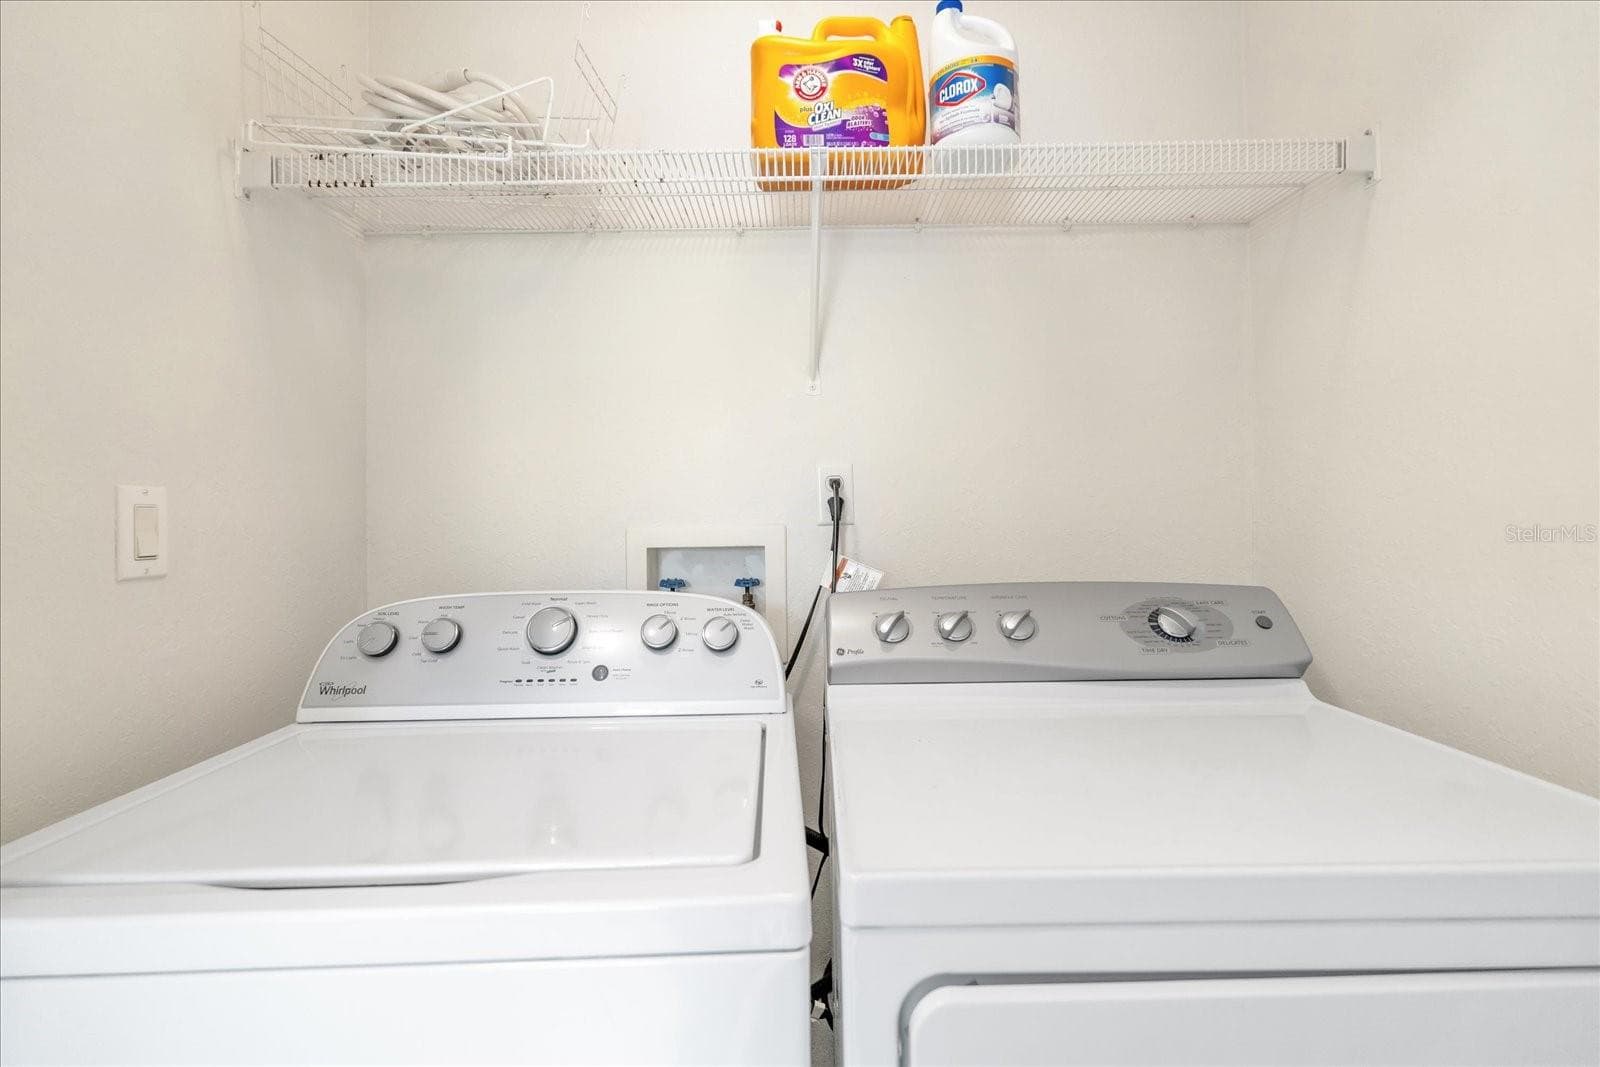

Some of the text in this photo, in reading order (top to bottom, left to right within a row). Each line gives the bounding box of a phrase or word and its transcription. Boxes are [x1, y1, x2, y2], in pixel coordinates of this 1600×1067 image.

[939, 78, 979, 103] CLOROX
[814, 101, 834, 113] OXI
[808, 109, 842, 125] CLEAN
[319, 685, 367, 698] Whirlpool
